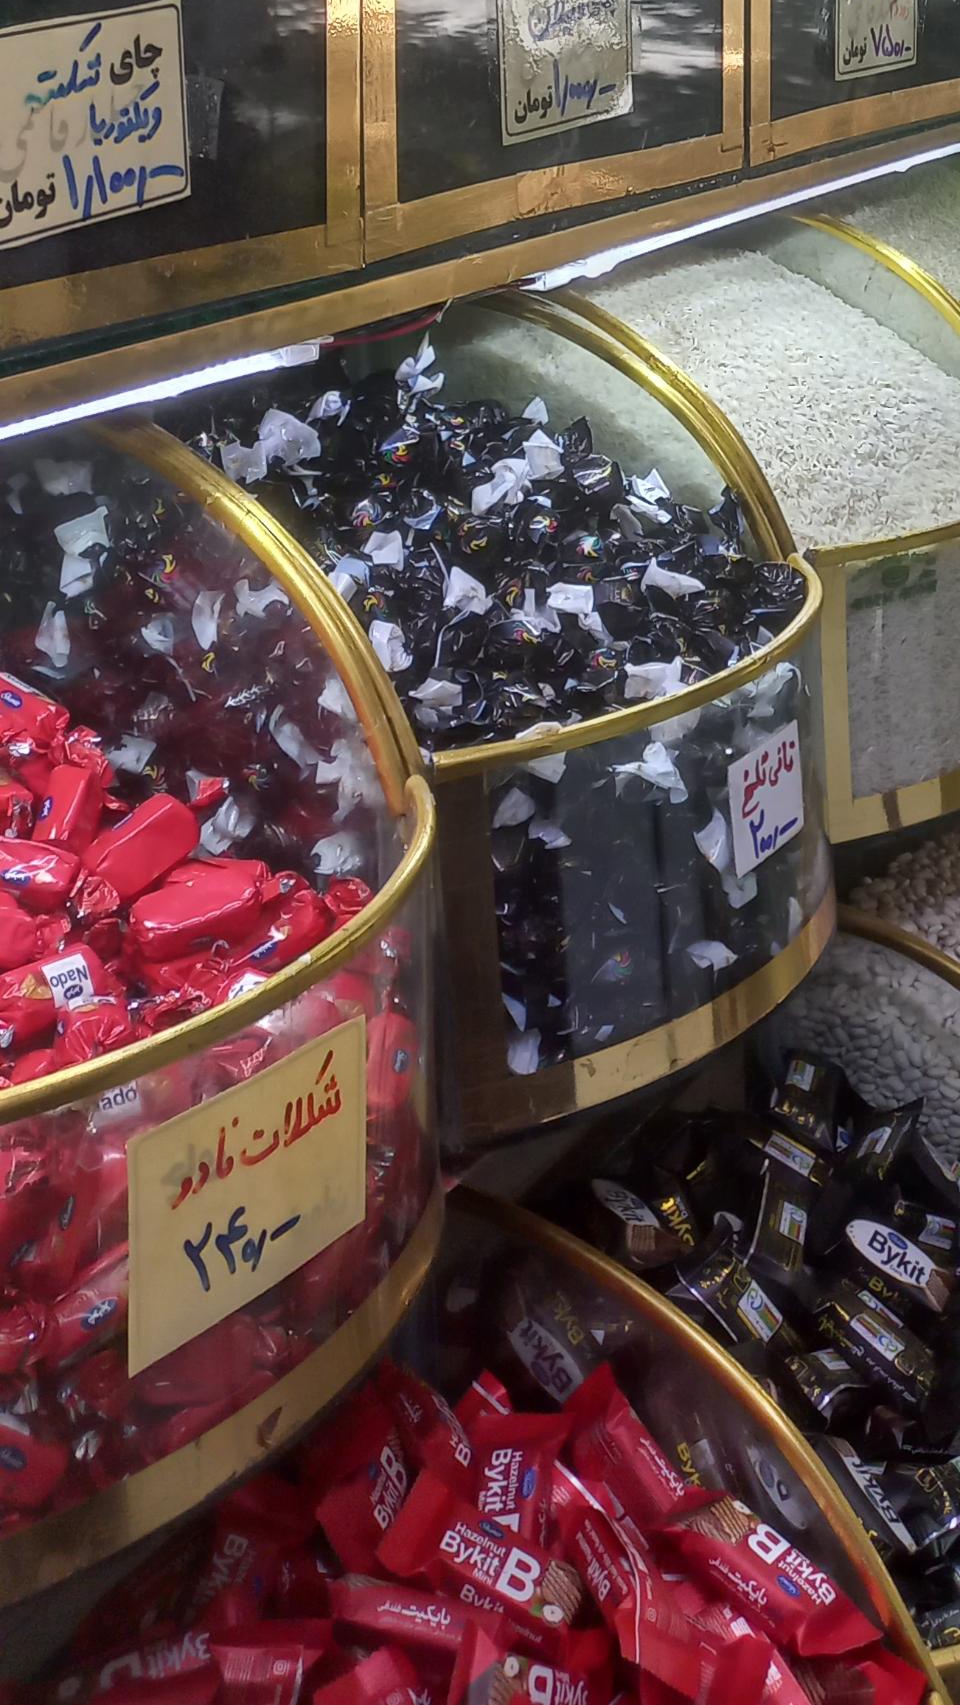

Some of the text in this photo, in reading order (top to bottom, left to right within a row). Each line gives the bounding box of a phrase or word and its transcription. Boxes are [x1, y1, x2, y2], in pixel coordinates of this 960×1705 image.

[110, 33, 164, 86] چای
[842, 36, 868, 66] تومان
[514, 85, 553, 125] تومان
[49, 963, 90, 989] Nado
[96, 1085, 138, 1111] ado
[867, 1228, 927, 1285] Bykit
[484, 1447, 512, 1514] Bykit
[507, 1449, 524, 1511] Hazelnut
[676, 1441, 706, 1488] Byk
[439, 1529, 500, 1578] Bykit
[454, 1521, 508, 1557] Hazelnut
[496, 1547, 542, 1603] B
[784, 1549, 837, 1606] Bykit
